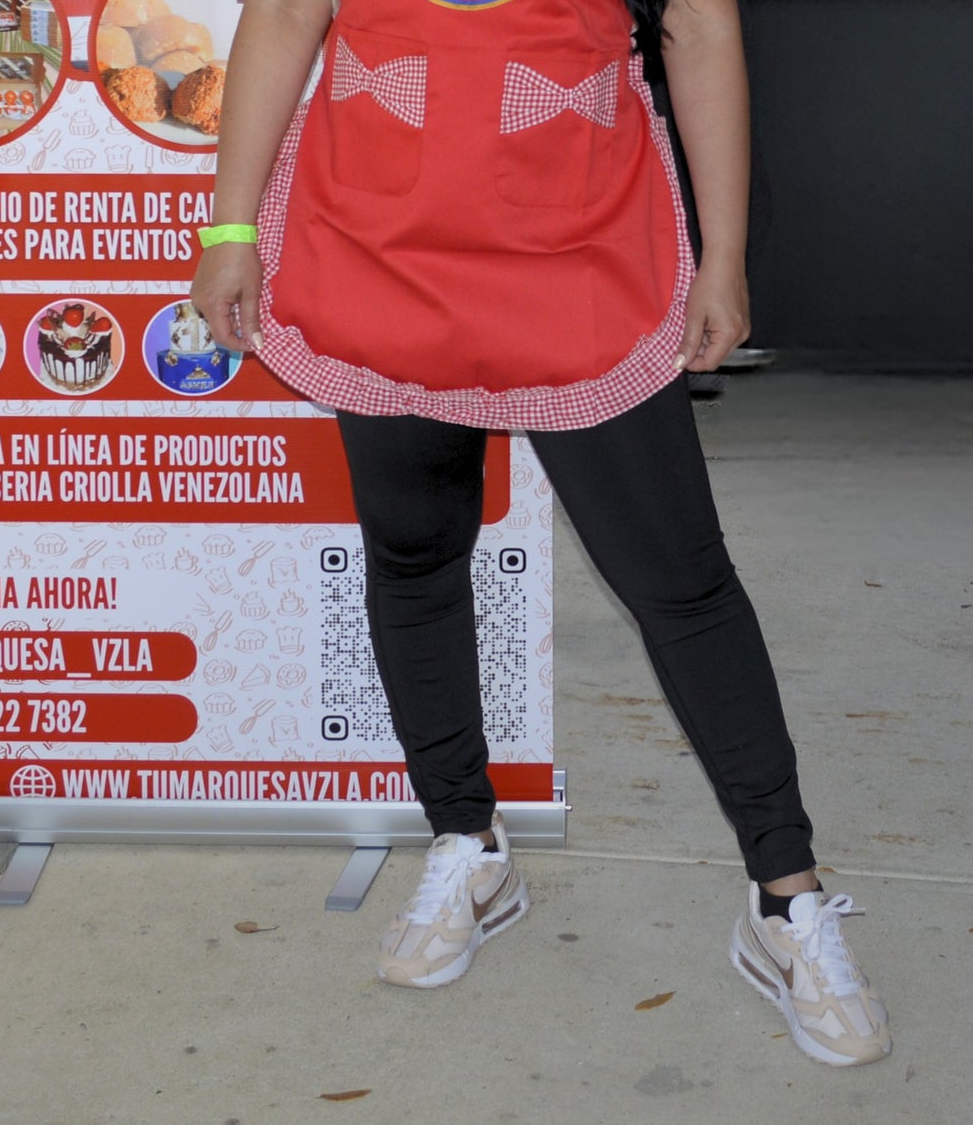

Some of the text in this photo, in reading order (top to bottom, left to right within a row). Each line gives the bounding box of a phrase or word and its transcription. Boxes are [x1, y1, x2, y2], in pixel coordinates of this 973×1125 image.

[29, 191, 59, 224] DE
[68, 192, 137, 224] RENTA
[144, 192, 173, 224] DE
[25, 228, 86, 261] PARA
[92, 228, 193, 261] EVENTOS
[11, 434, 40, 465] EN
[47, 428, 113, 466] LÍNEA
[119, 434, 147, 466] DE
[154, 435, 287, 467] PRODUCTOS
[59, 471, 153, 503] CRIOLLA
[159, 472, 305, 504] VENEZOLANA
[27, 577, 117, 610] AHORA!
[28, 699, 87, 734] 7382
